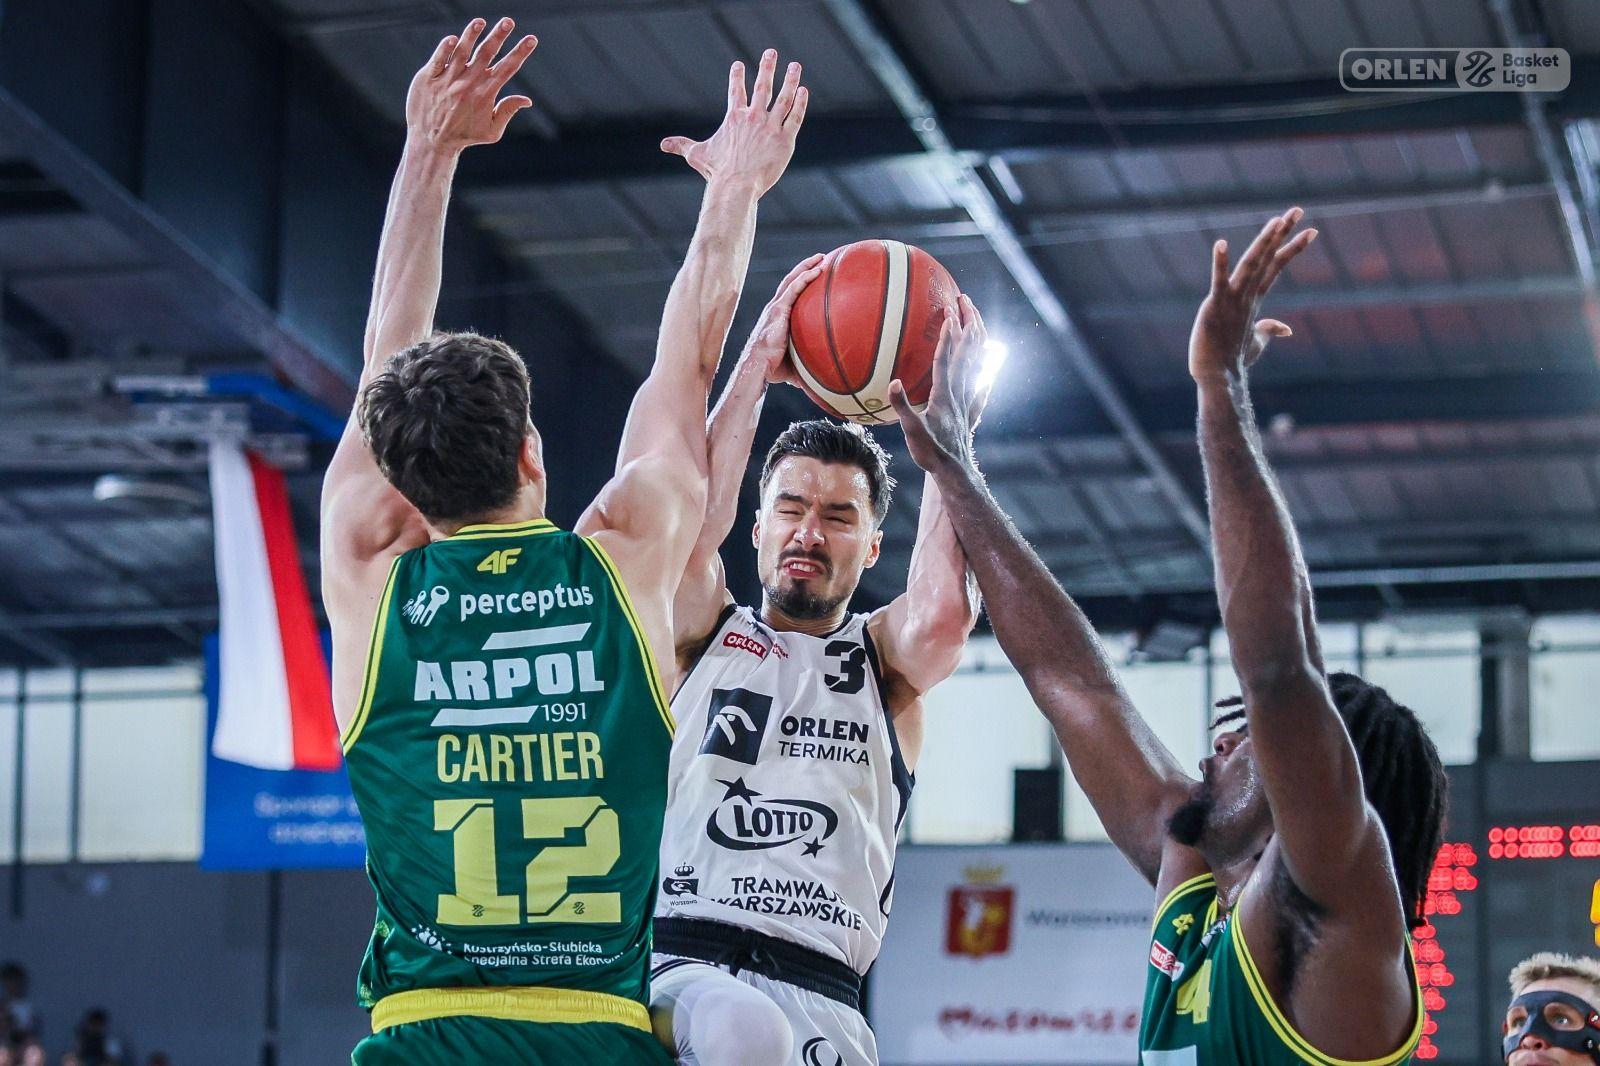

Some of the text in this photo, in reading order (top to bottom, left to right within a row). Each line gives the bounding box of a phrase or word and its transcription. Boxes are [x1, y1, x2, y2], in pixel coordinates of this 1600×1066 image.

[476, 547, 522, 575] 4F
[460, 582, 594, 623] perceptus
[727, 634, 762, 655] ORLEN
[413, 650, 605, 702] ARPOL
[824, 640, 867, 695] 3
[540, 702, 588, 723] 1991
[780, 715, 870, 744] ORLEN
[436, 731, 605, 783] CARTIER
[778, 740, 870, 767] TERMIKA
[733, 804, 814, 839] LOTTO
[433, 796, 622, 926] 12
[531, 953, 572, 966] Strefa
